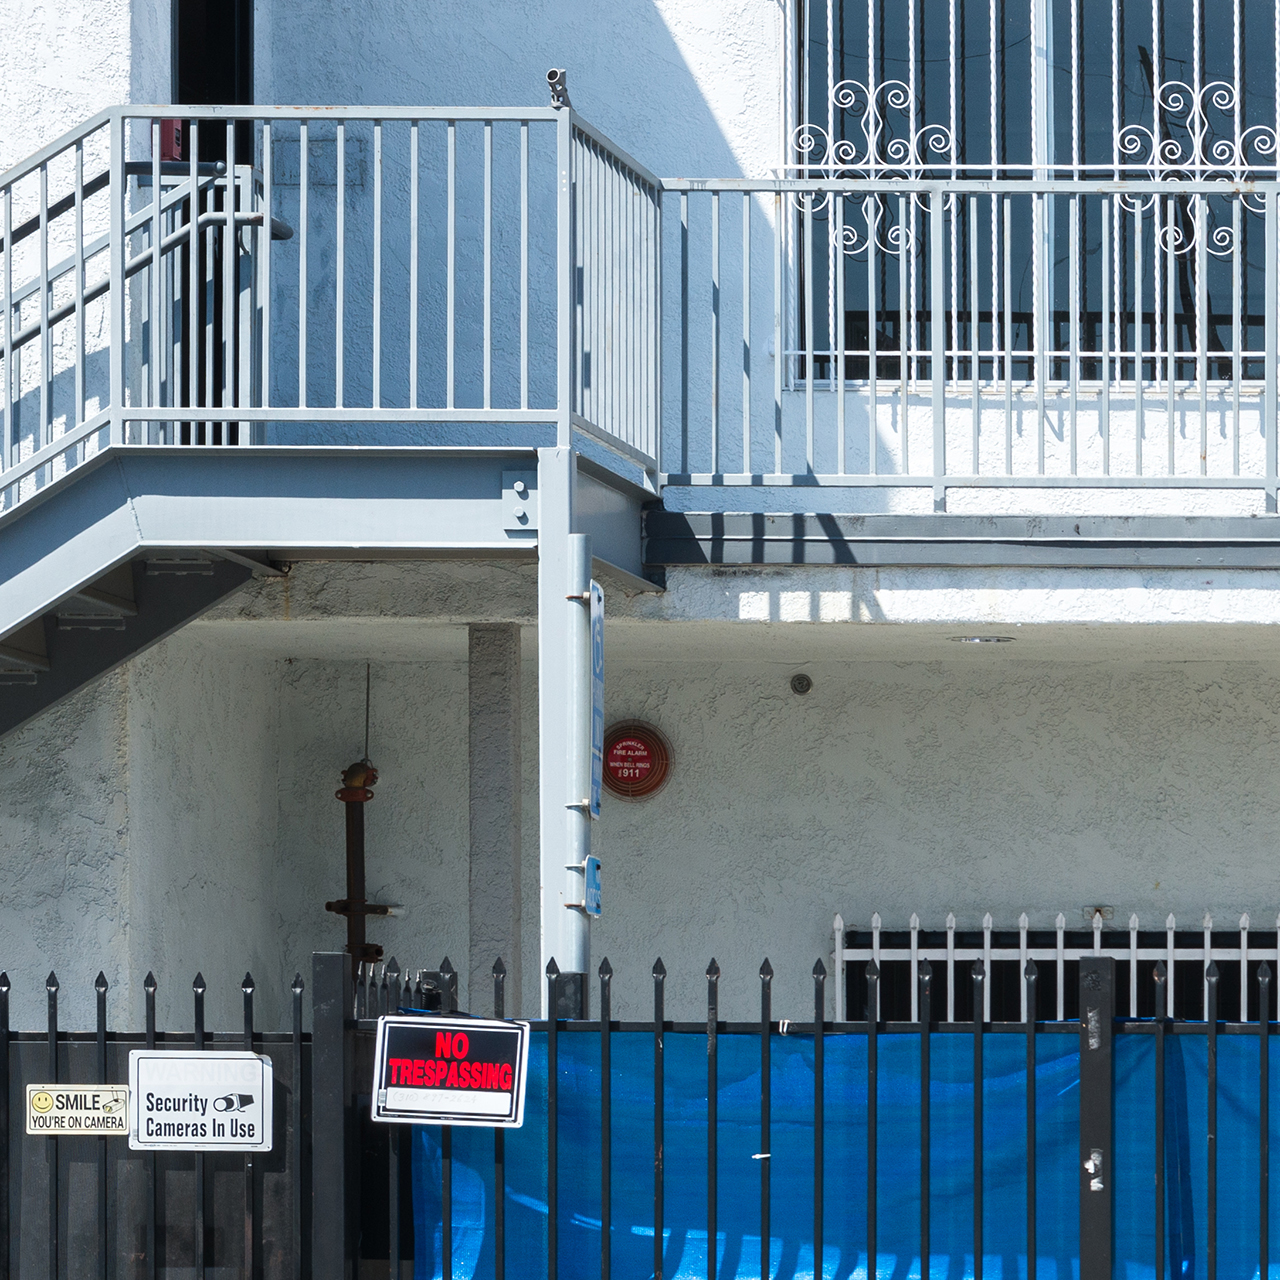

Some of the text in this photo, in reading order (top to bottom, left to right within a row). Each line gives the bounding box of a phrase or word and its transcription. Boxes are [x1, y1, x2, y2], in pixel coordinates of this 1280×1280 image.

[616, 741, 645, 750] SPRINKLER
[623, 769, 639, 777] 911
[435, 1032, 469, 1059] NO
[145, 1062, 257, 1083] WARNING
[389, 1058, 513, 1091] TRESPASSING
[55, 1094, 100, 1111] SMILE
[146, 1092, 208, 1117] Security
[32, 1115, 124, 1129] YOU'RE ON CAMERA
[146, 1117, 255, 1138] Cameras In Use
